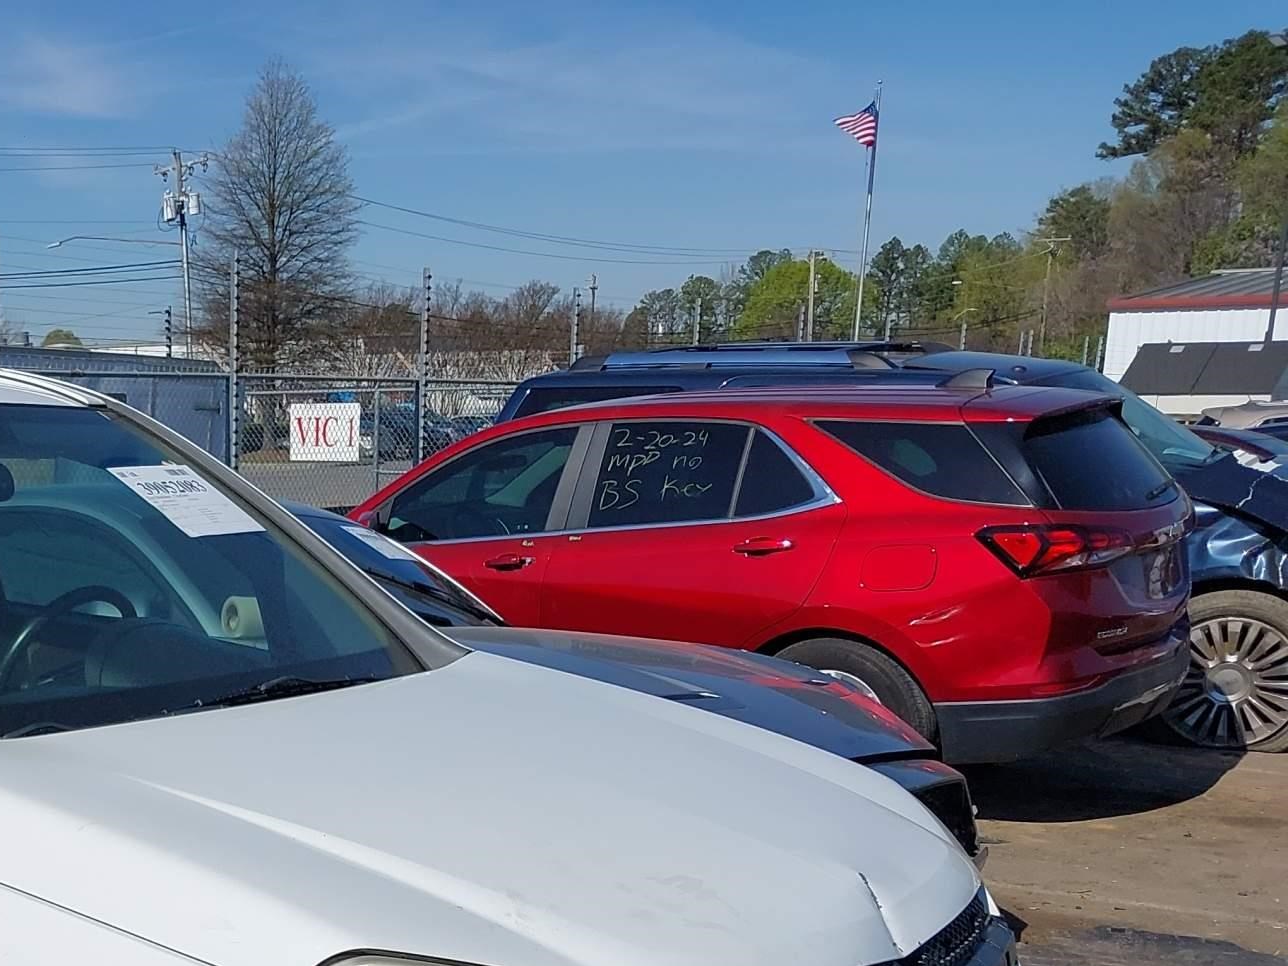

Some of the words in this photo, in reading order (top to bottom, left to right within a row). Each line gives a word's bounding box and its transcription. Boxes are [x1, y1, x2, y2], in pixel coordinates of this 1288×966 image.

[295, 415, 338, 448] VIC
[136, 479, 209, 496] 39052083
[599, 479, 643, 511] BS
